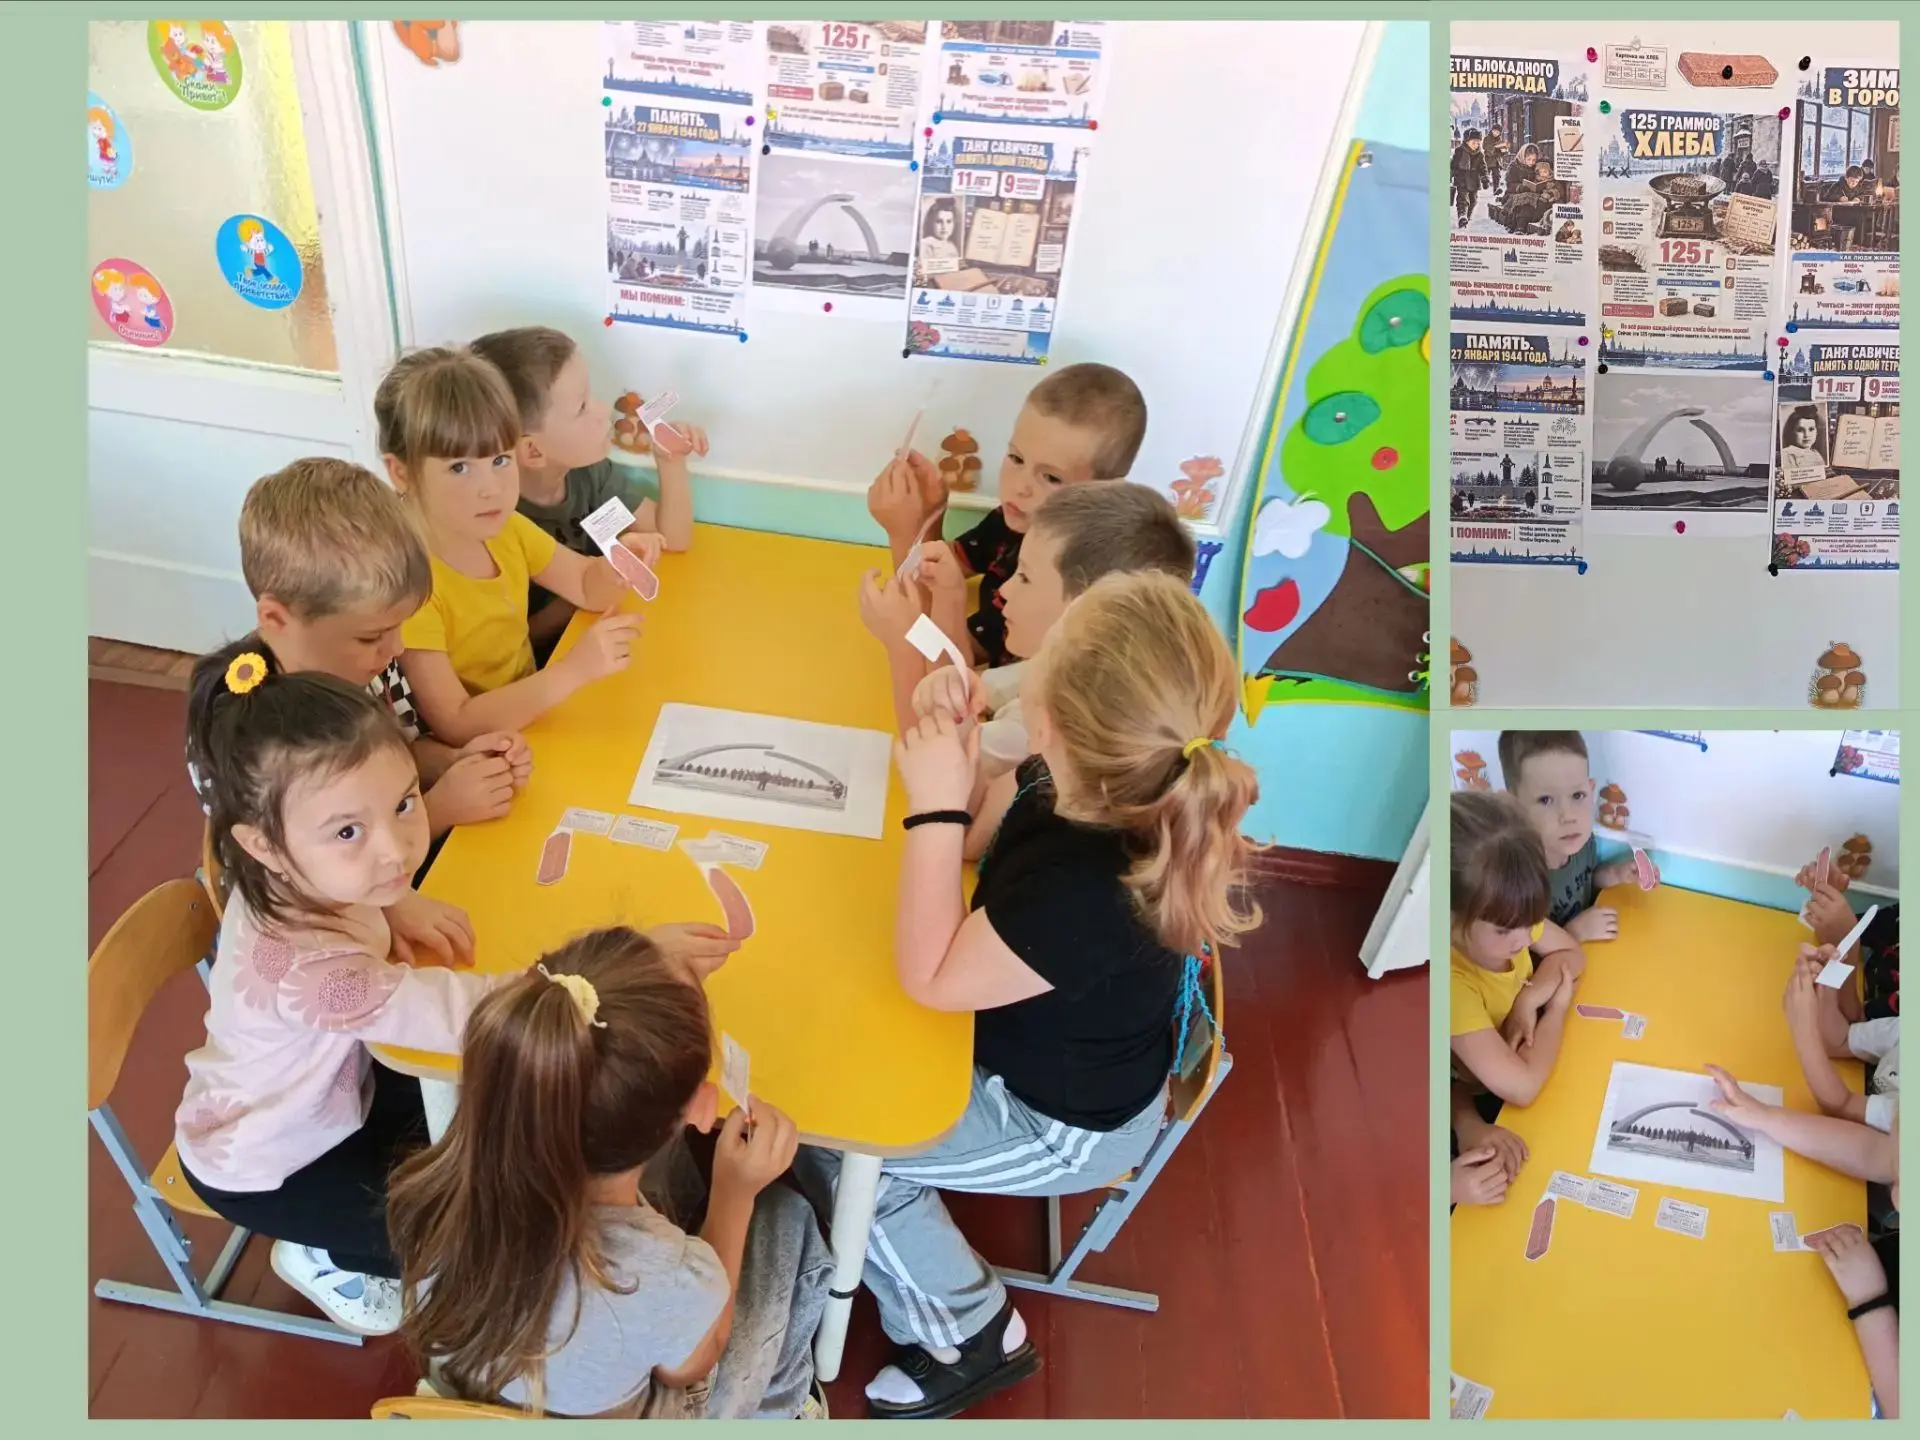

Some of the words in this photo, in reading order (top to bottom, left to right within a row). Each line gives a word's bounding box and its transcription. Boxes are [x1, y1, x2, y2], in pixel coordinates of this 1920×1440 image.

[822, 24, 858, 48] 125
[862, 33, 871, 49] г
[1474, 59, 1554, 78] БЛОКАДНОГО
[1450, 72, 1547, 93] ЛЕНИНГРАДА
[1843, 69, 1899, 88] ЗИМ
[1829, 88, 1842, 105] В
[1848, 89, 1899, 106] ГОРО
[650, 108, 708, 128] ПАМЯТЬ.
[1561, 119, 1581, 127] УЧЁБА
[1629, 113, 1658, 130] 125
[1660, 115, 1720, 131] ГРАММОВ
[636, 121, 647, 132] 27
[962, 140, 989, 153] ТАНЯ
[1634, 131, 1717, 157] ХЛЕБА
[957, 171, 973, 186] 11
[974, 176, 992, 187] ЛЕТ
[1004, 174, 1015, 193] 9
[1450, 233, 1468, 242] Дети
[1469, 235, 1488, 243] тоже
[1488, 236, 1521, 245] помогали
[1660, 240, 1701, 264] 125
[1705, 249, 1714, 265] г
[620, 289, 638, 301] МЫ
[640, 291, 686, 307] ПОМНИМ:
[1457, 289, 1485, 297] сделать
[1817, 301, 1844, 309] Учиться
[1466, 335, 1534, 351] ПАМЯТЬ.
[1451, 349, 1462, 360] 27
[1464, 349, 1500, 361] ЯНВАРЯ
[1501, 350, 1523, 362] 1944
[1524, 352, 1548, 364] ГОДА
[1820, 346, 1849, 359] ТАНЯ
[1813, 361, 1847, 372] ПАМЯТЬ
[1847, 360, 1853, 371] В
[1854, 359, 1880, 371] ОДНОЙ
[1817, 378, 1834, 393] 11
[1835, 382, 1856, 393] ЛЕТ
[1868, 378, 1881, 398] 9
[1456, 526, 1512, 540] ПОМНИМ:
